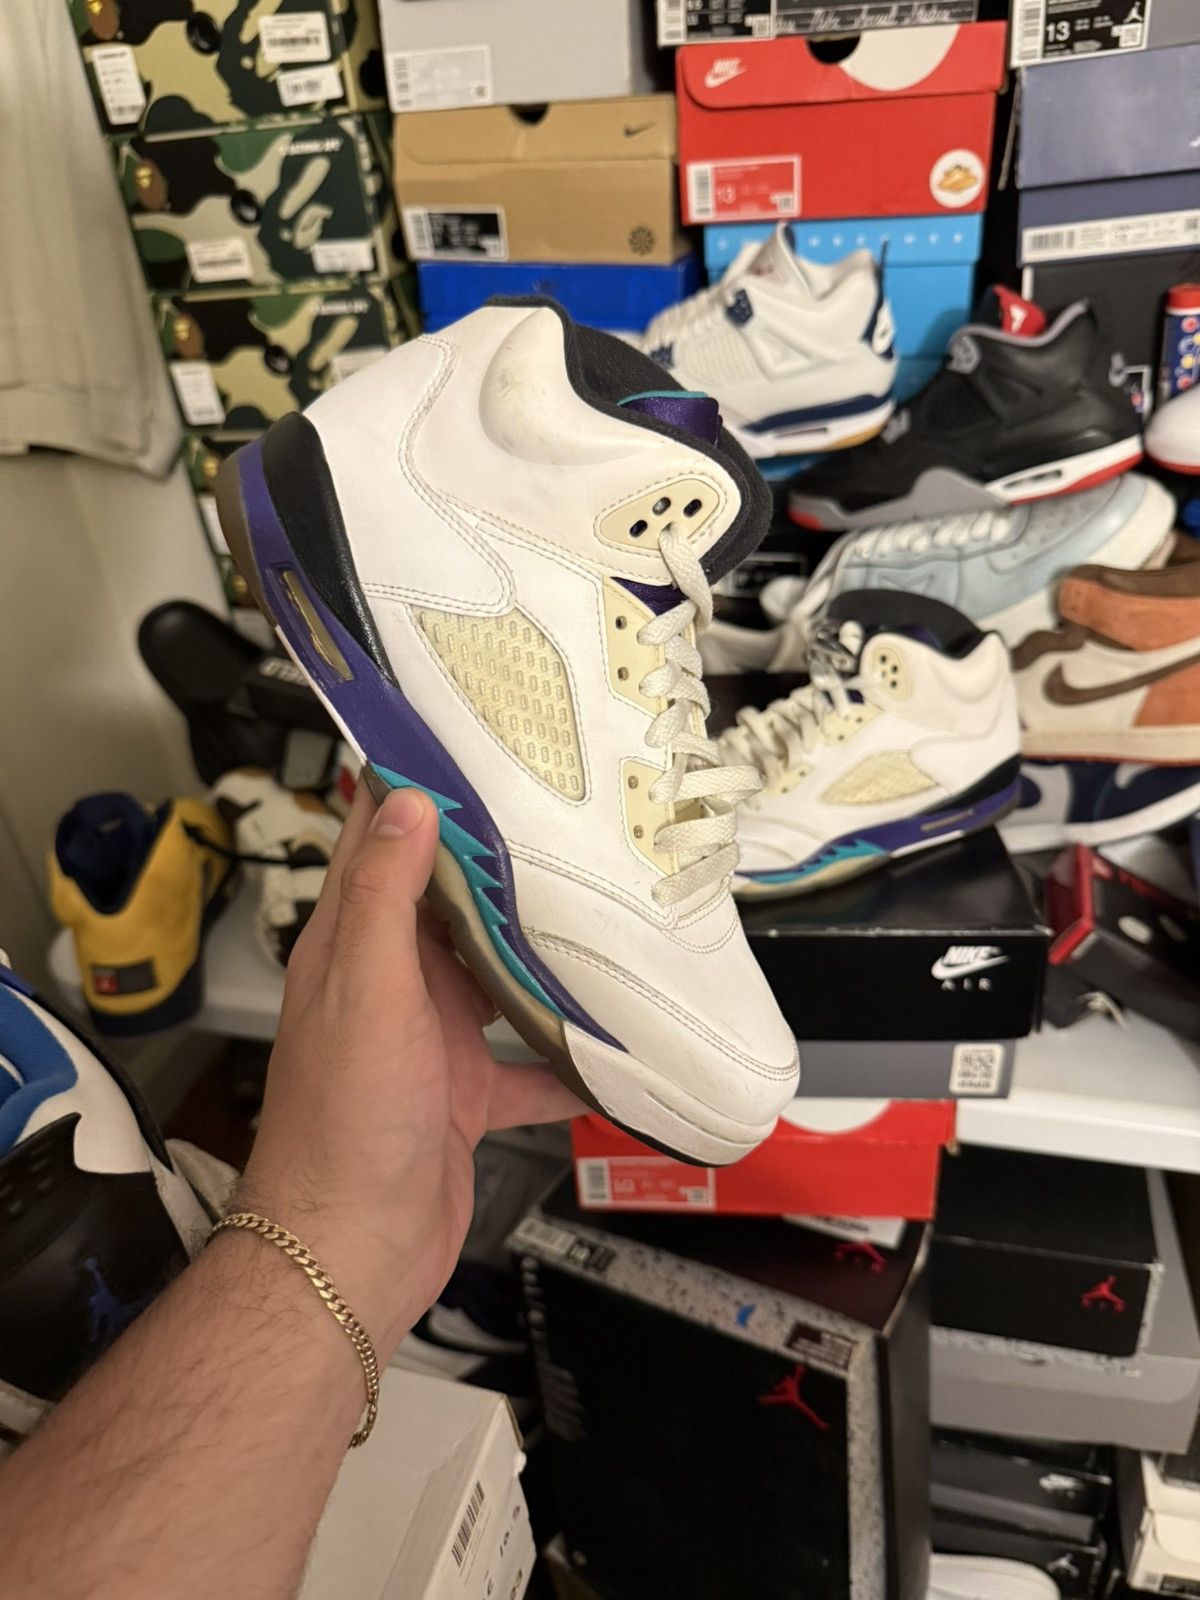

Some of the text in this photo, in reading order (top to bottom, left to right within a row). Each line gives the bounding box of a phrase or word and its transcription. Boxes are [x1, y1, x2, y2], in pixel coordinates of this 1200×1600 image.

[1045, 20, 1071, 43] 13
[942, 945, 998, 965] NIKE
[941, 977, 993, 992] AIR
